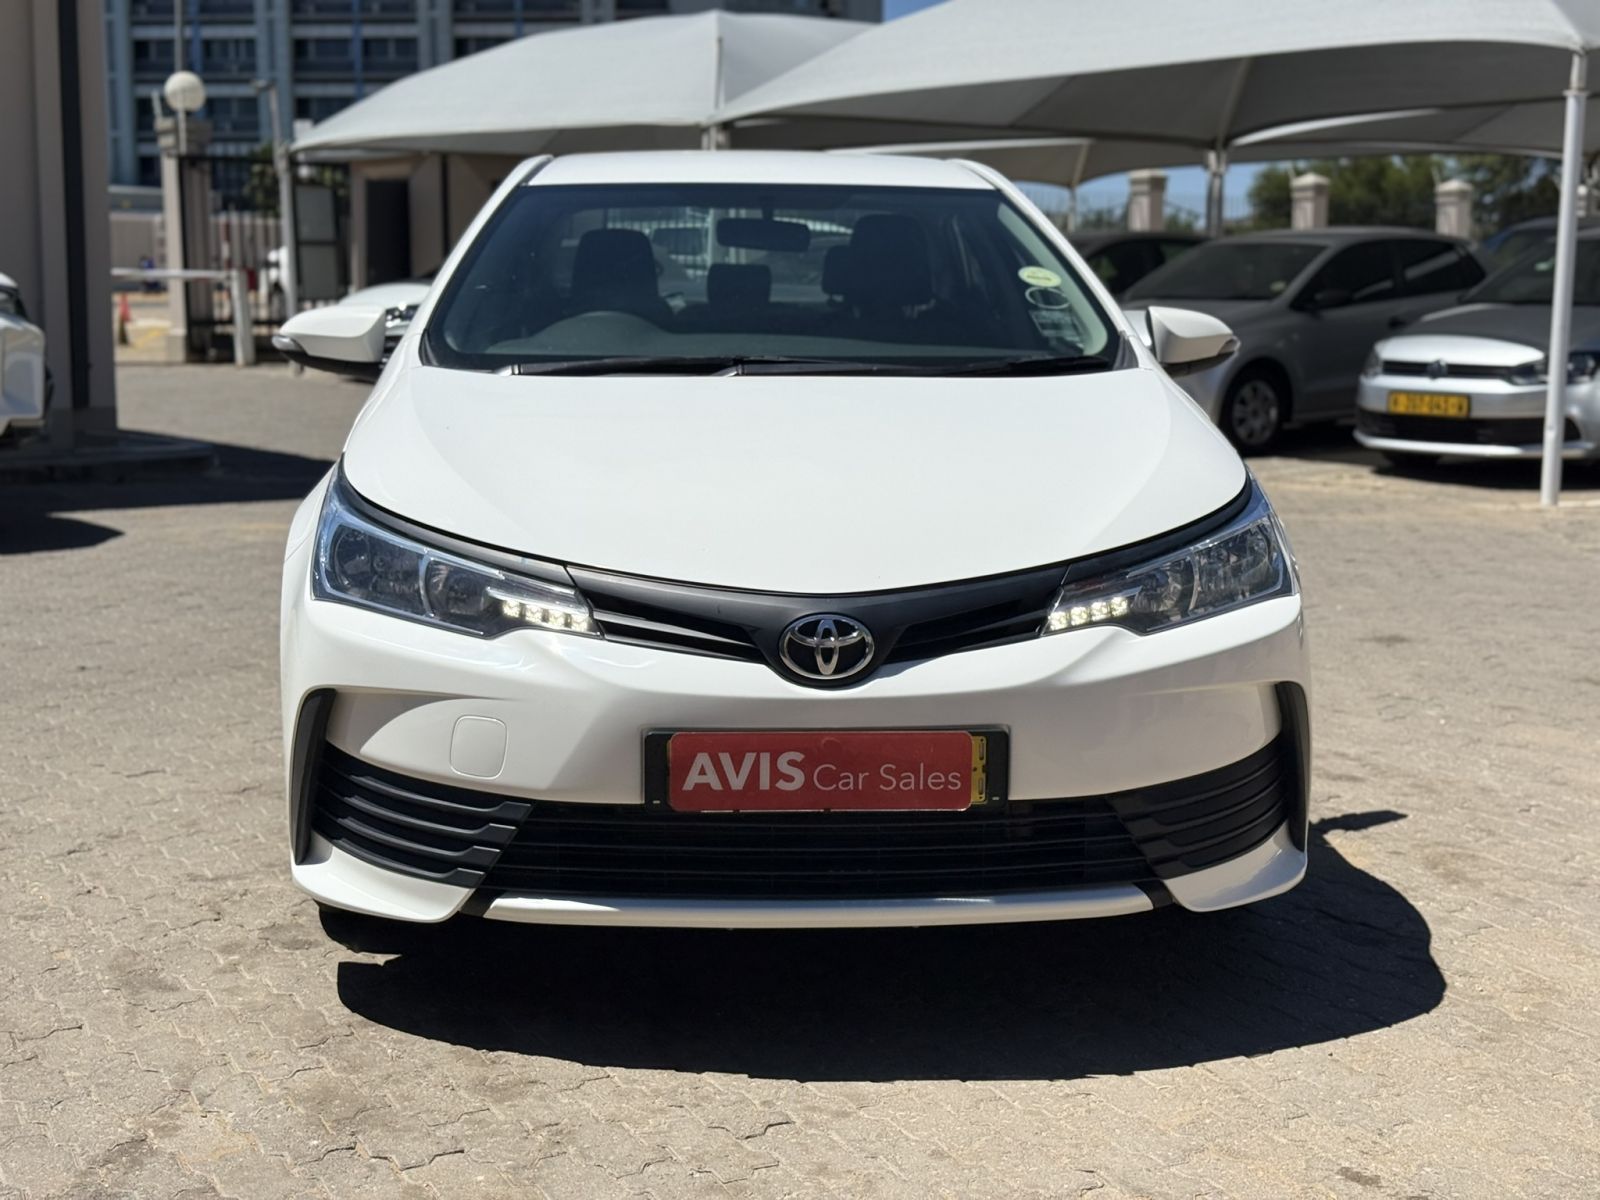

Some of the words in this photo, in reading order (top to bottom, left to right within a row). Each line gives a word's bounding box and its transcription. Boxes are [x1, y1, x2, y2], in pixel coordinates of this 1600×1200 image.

[682, 752, 805, 791] AVIS
[812, 763, 869, 791] Car
[879, 762, 962, 791] Sales
